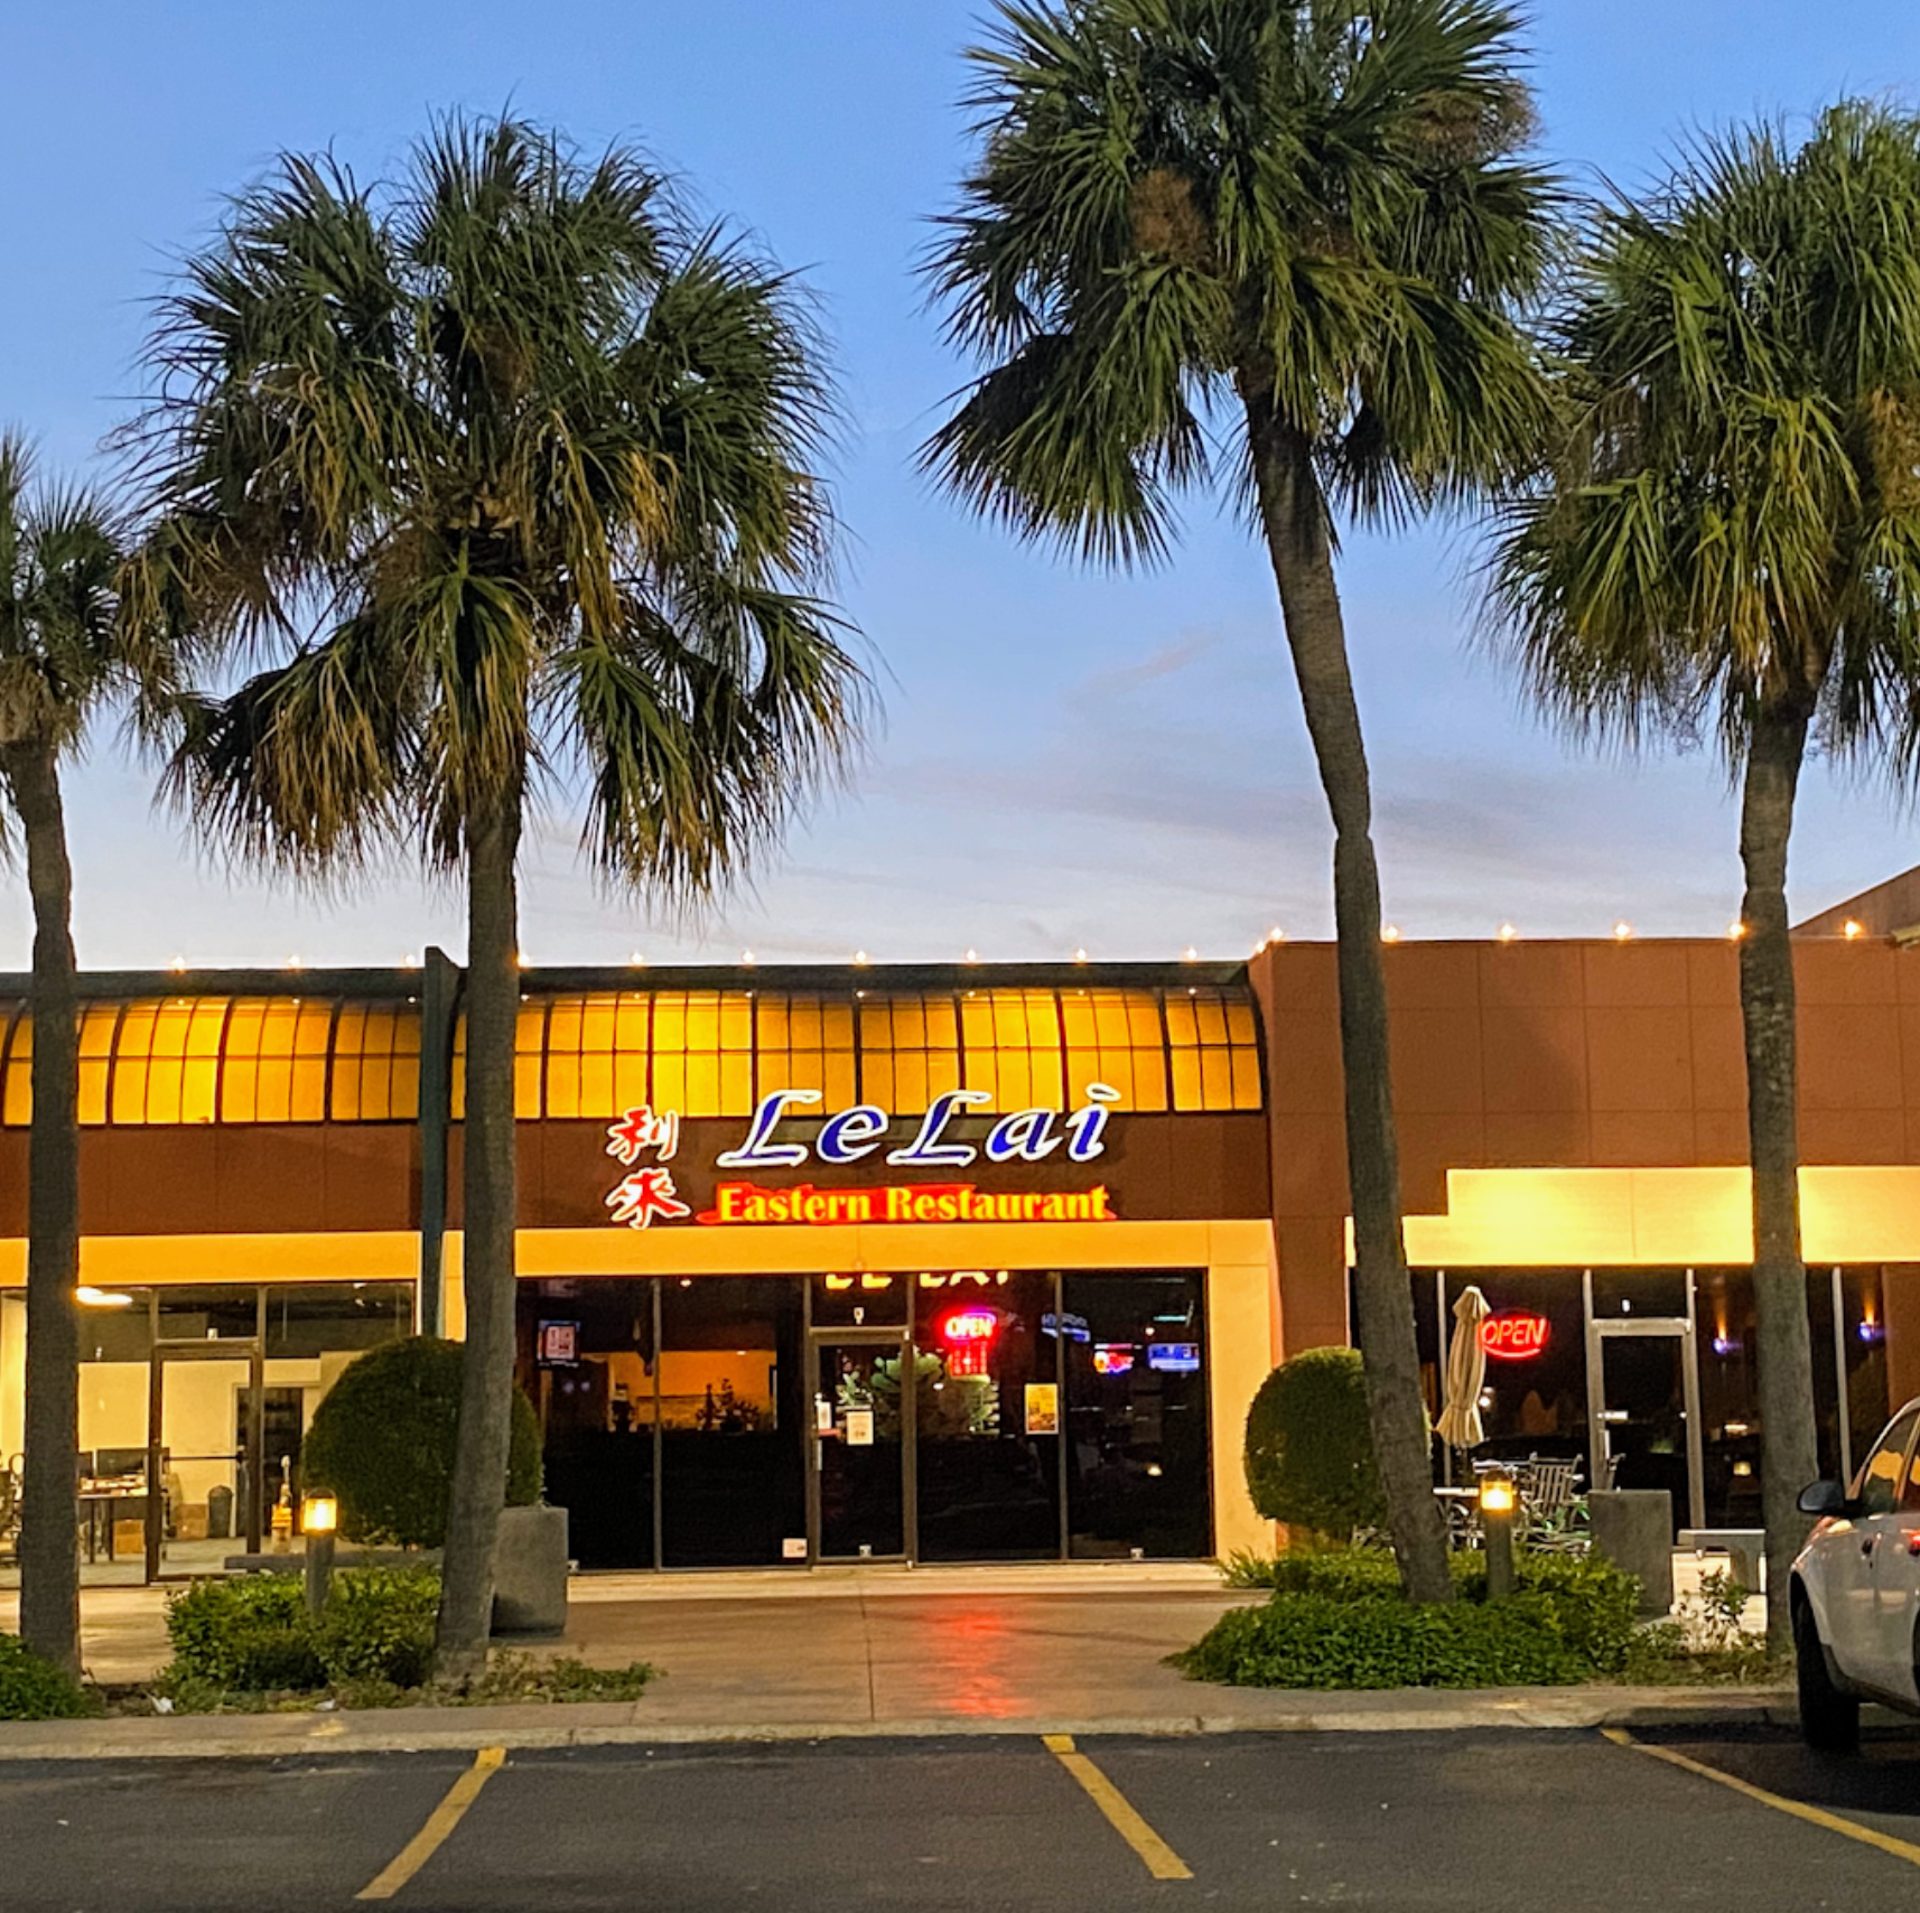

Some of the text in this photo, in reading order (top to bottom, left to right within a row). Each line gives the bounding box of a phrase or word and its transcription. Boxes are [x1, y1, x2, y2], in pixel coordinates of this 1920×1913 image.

[719, 1185, 1110, 1222] Eastern Restaurant
[946, 1316, 993, 1339] OPEN
[1481, 1317, 1547, 1346] OPEN
